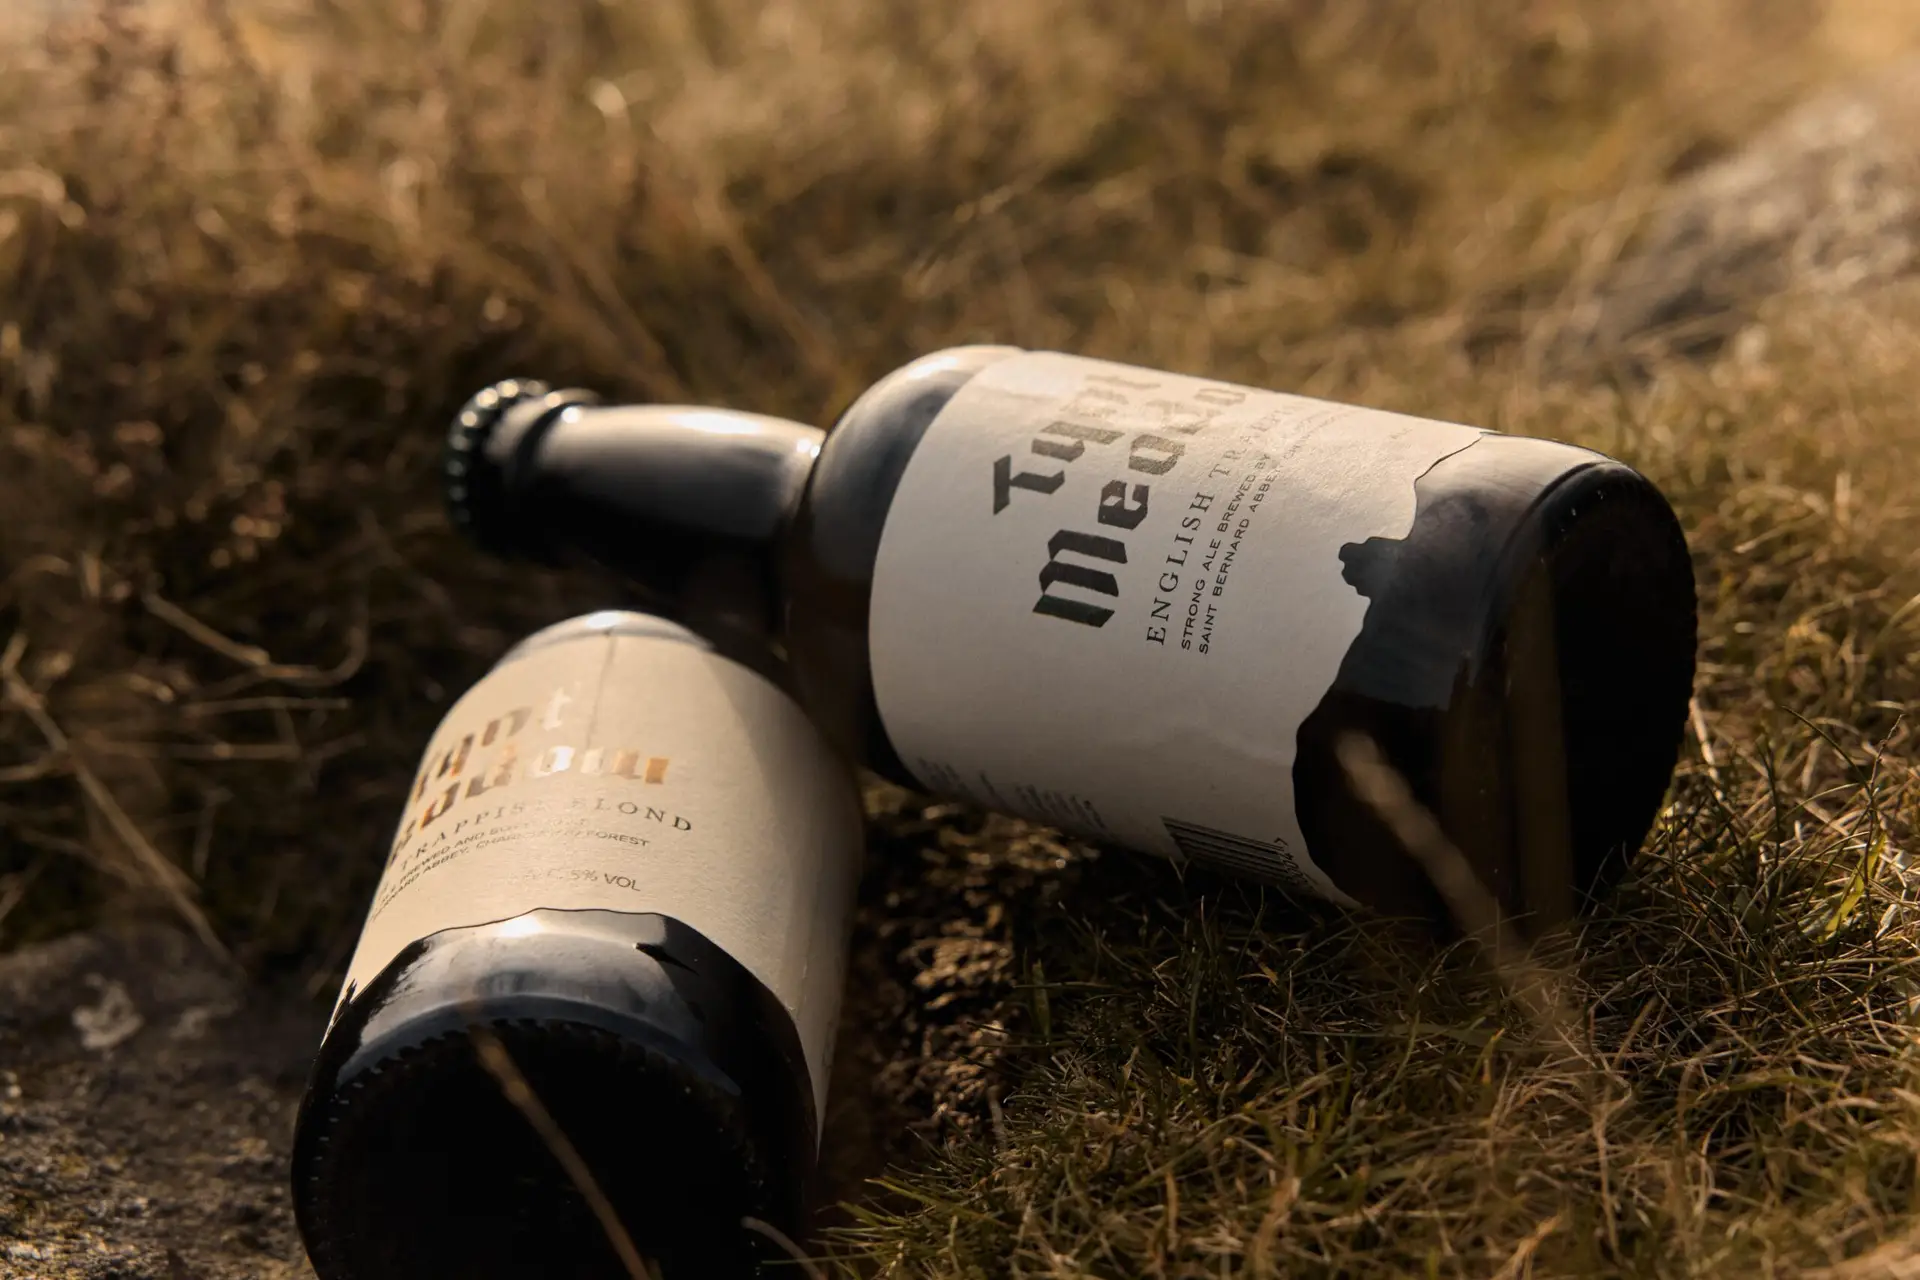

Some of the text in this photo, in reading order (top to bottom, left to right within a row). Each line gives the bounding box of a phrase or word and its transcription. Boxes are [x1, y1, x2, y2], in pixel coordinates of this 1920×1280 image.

[1146, 491, 1216, 646] ENGLISH
[1182, 452, 1272, 651] STRONG ALE BREWED BY
[1199, 605, 1218, 655] SAINT
[1211, 518, 1250, 598] BERNARD
[603, 872, 641, 892] VOL
